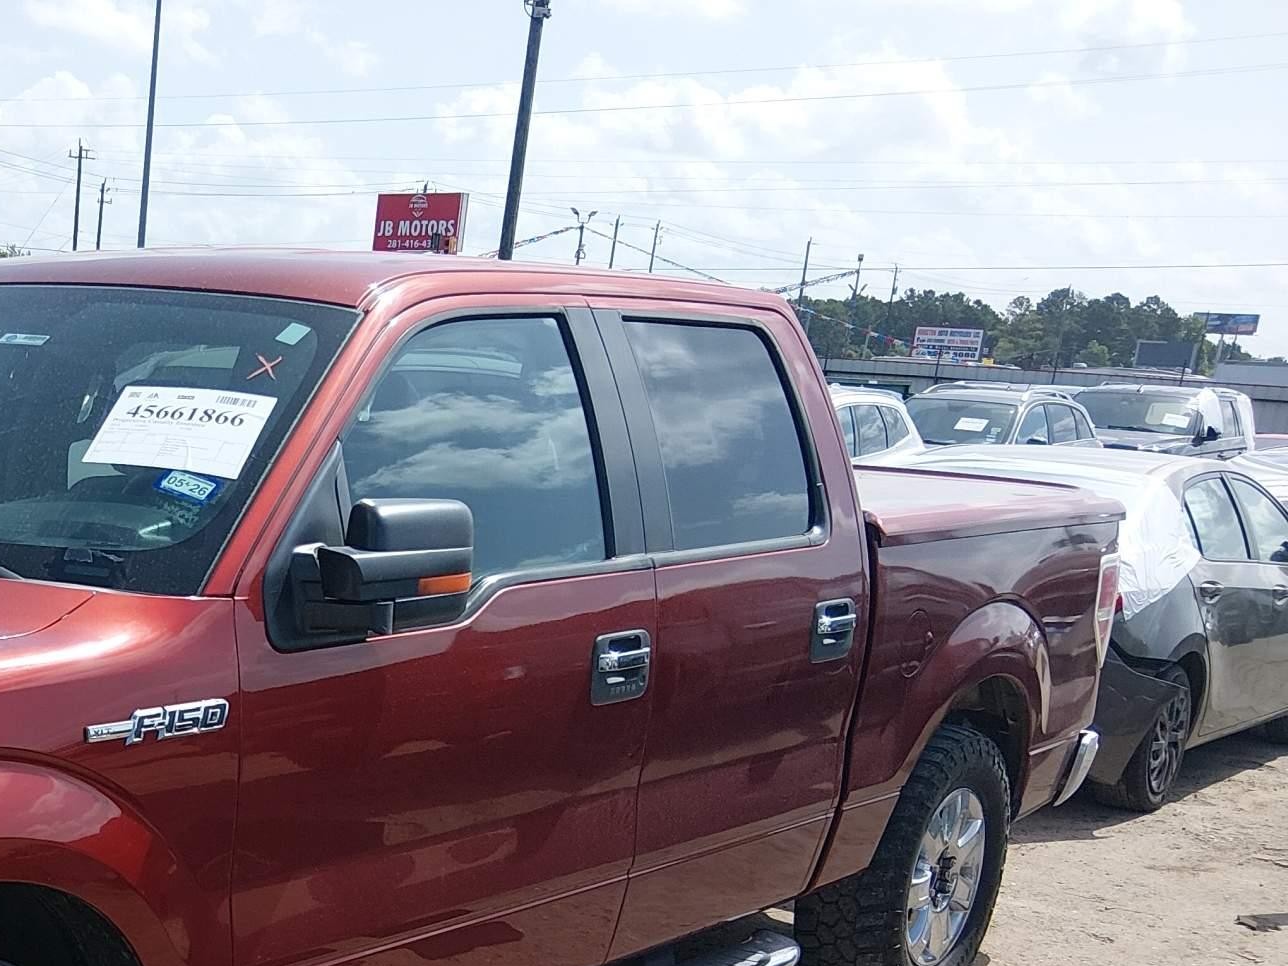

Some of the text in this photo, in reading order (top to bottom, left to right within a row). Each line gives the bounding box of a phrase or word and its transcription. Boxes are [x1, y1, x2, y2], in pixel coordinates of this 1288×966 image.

[377, 219, 456, 237] JB MOTORS
[387, 239, 432, 249] 281-416-43
[126, 403, 249, 428] 45661866
[166, 475, 209, 496] 05 26
